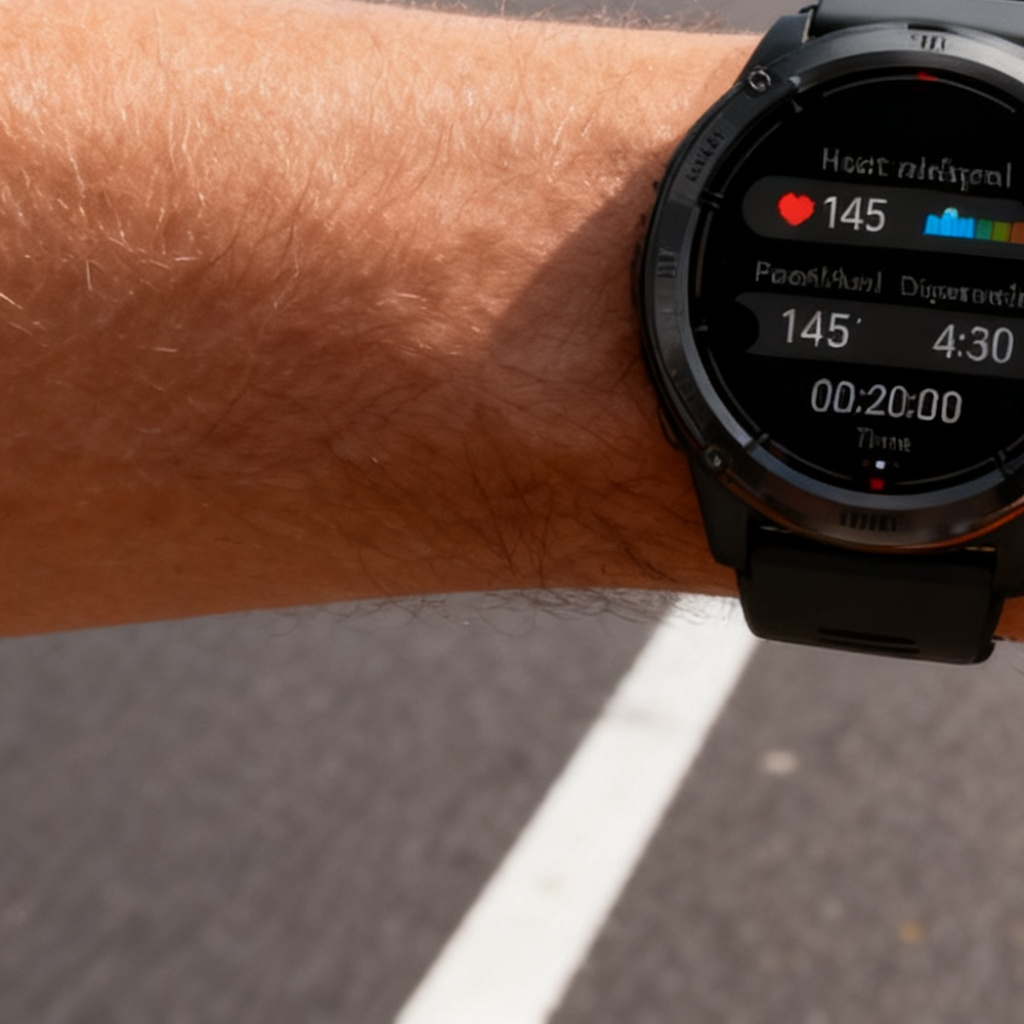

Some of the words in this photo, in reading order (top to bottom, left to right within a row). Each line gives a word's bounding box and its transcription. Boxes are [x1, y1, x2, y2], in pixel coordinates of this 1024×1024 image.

[823, 196, 888, 232] 145
[932, 323, 1014, 363] 4:30
[811, 378, 963, 424] 00:20:00
